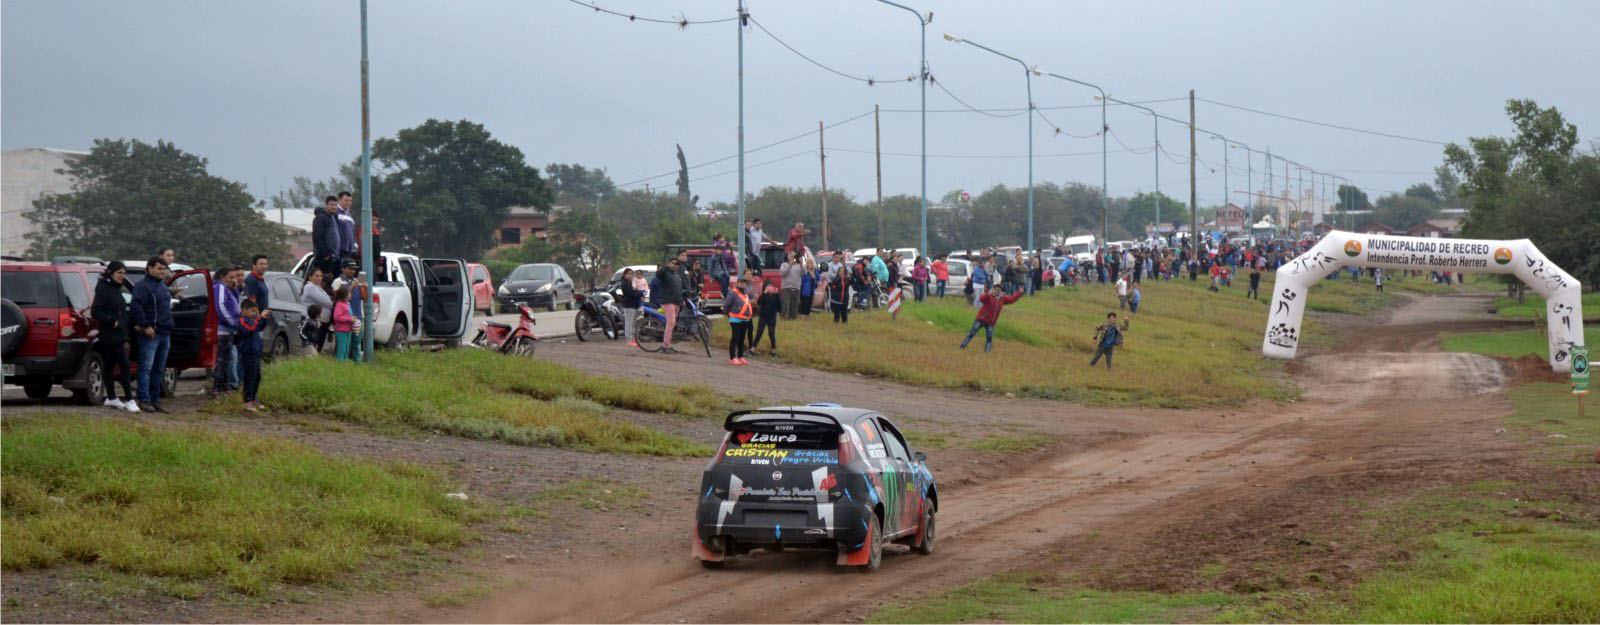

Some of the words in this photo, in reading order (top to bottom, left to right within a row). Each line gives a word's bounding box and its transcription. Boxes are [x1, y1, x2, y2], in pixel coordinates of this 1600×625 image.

[1367, 238, 1436, 253] MUNICIPALIDAD
[1439, 242, 1451, 253] DE
[1453, 243, 1489, 255] RECREO
[1367, 252, 1409, 264] Intendencia
[1410, 254, 1427, 265] Prof.
[1429, 255, 1458, 267] Roberto
[1459, 256, 1488, 268] Herrera
[750, 432, 797, 442] Laura
[725, 448, 788, 458] CRISTIAN
